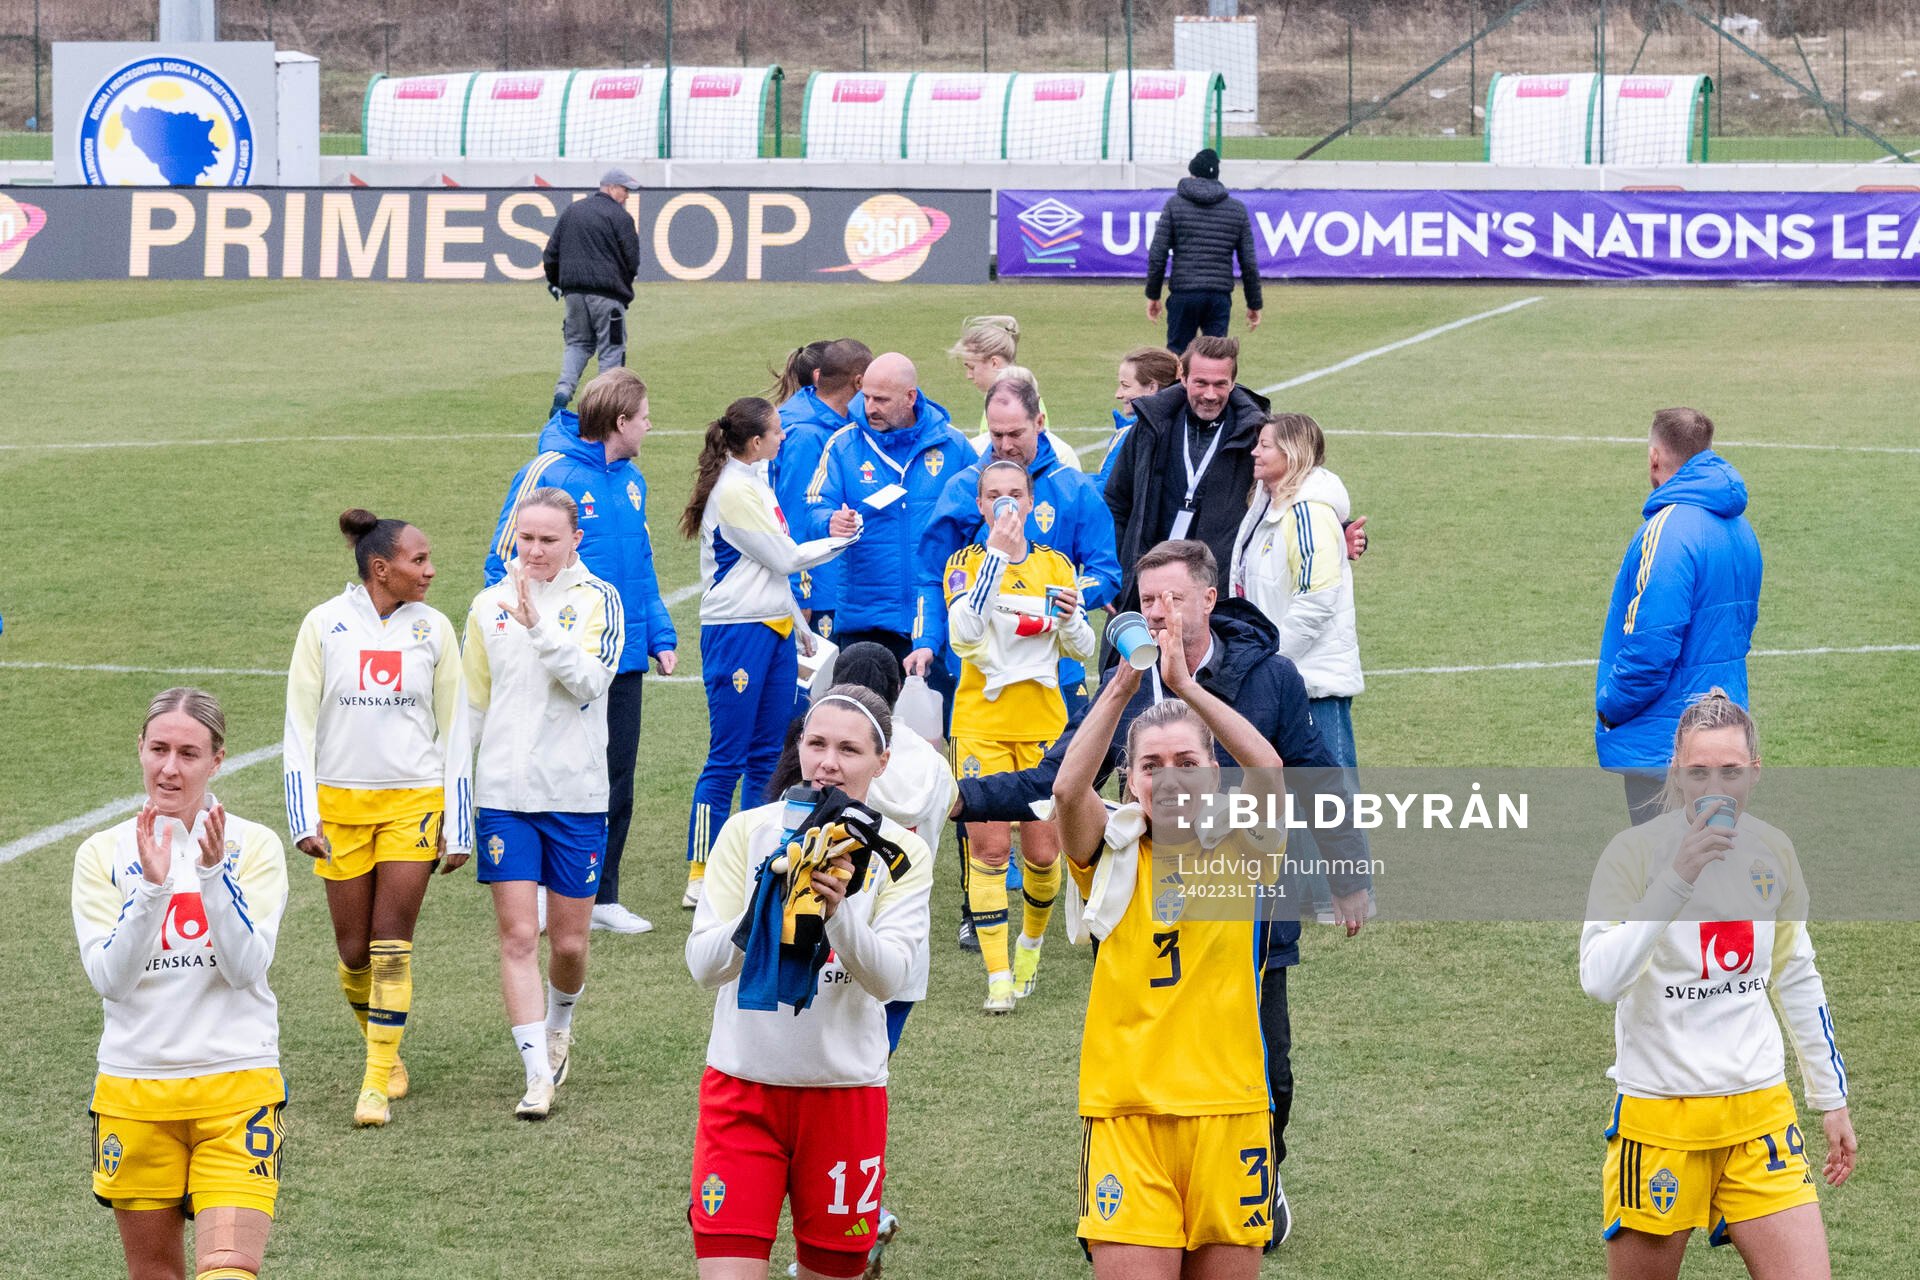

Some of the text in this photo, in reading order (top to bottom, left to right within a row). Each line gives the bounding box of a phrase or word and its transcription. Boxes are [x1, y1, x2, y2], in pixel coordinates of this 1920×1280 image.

[856, 216, 917, 256] 360
[1256, 210, 1537, 258] WOMEN’S
[1553, 211, 1816, 261] NATIONS
[339, 696, 391, 706] SVENSKA
[145, 955, 204, 972] VENSKA
[1150, 929, 1182, 989] 3
[1664, 981, 1733, 1000] SVENSKA
[245, 1105, 275, 1159] 6
[827, 1155, 882, 1215] 12
[1240, 1147, 1270, 1207] 3
